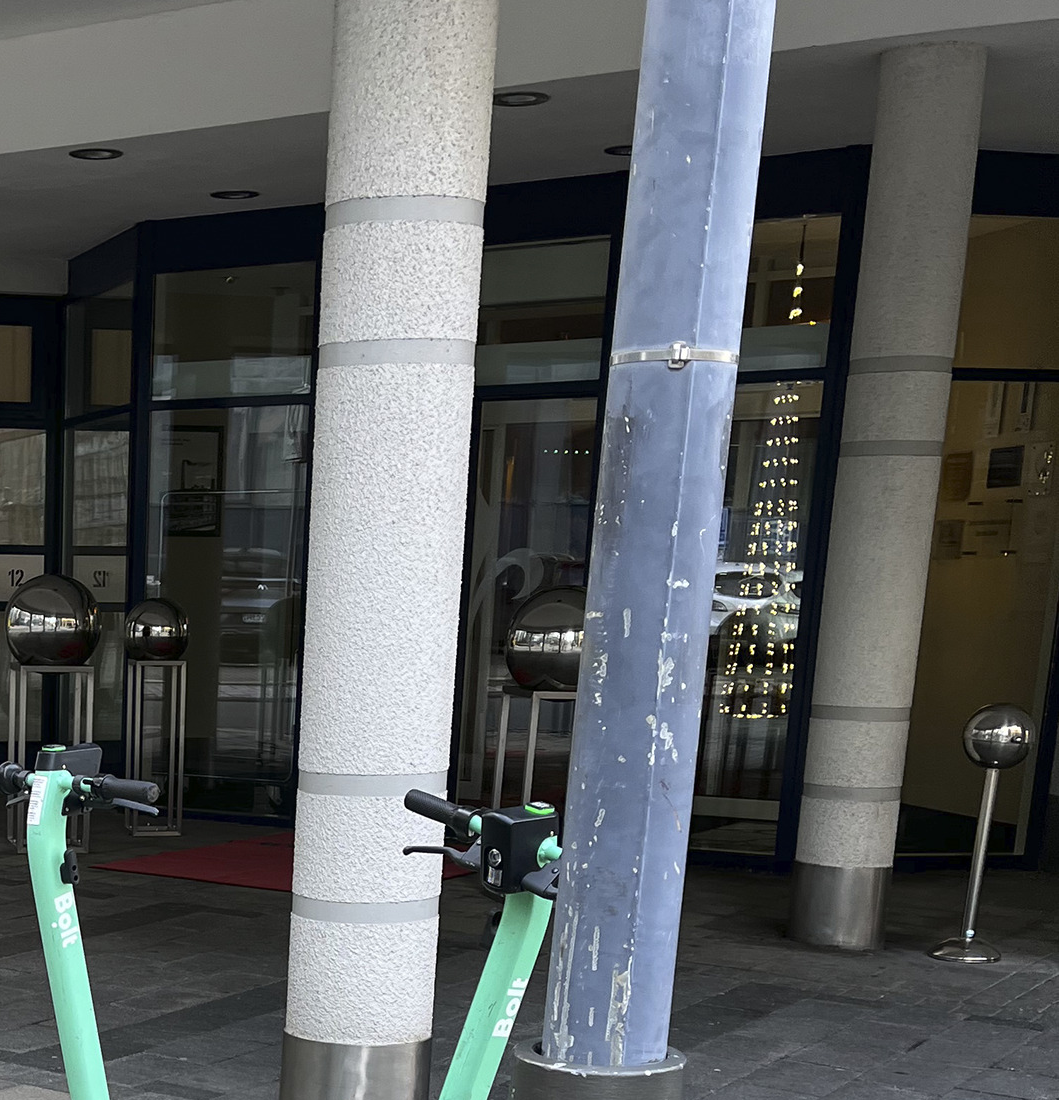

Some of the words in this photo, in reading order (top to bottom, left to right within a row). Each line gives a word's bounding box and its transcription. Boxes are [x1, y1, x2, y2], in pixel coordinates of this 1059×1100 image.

[8, 569, 25, 587] 12
[51, 891, 80, 949] Bolt
[492, 977, 530, 1038] Bolt
